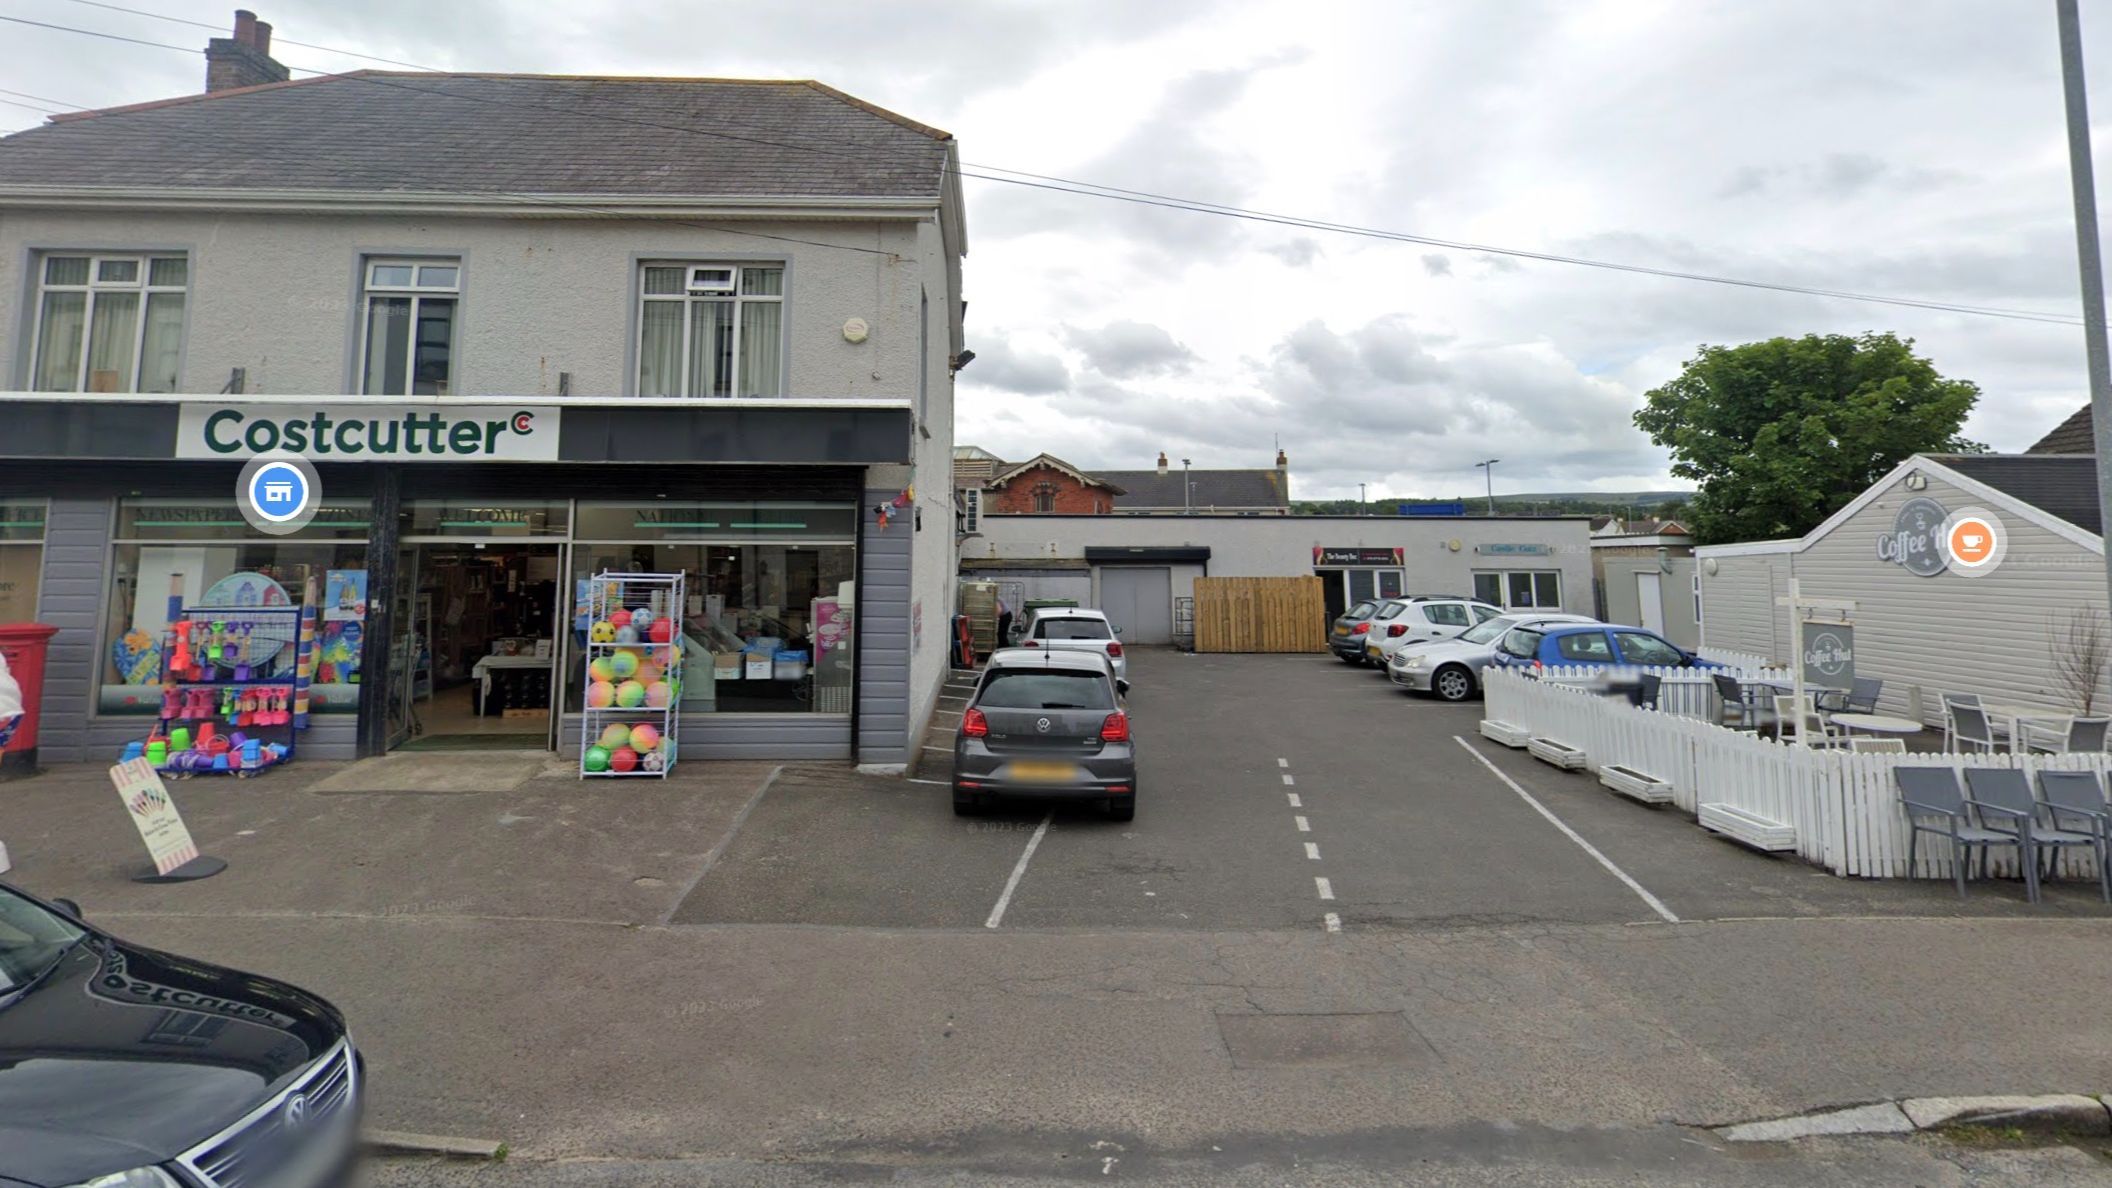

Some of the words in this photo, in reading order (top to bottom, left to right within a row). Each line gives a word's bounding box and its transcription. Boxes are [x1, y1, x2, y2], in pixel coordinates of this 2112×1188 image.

[204, 408, 507, 454] Costcutter
[1877, 530, 1928, 564] Coffee
[1805, 649, 1831, 667] Coffee
[1832, 647, 1852, 662] Hut
